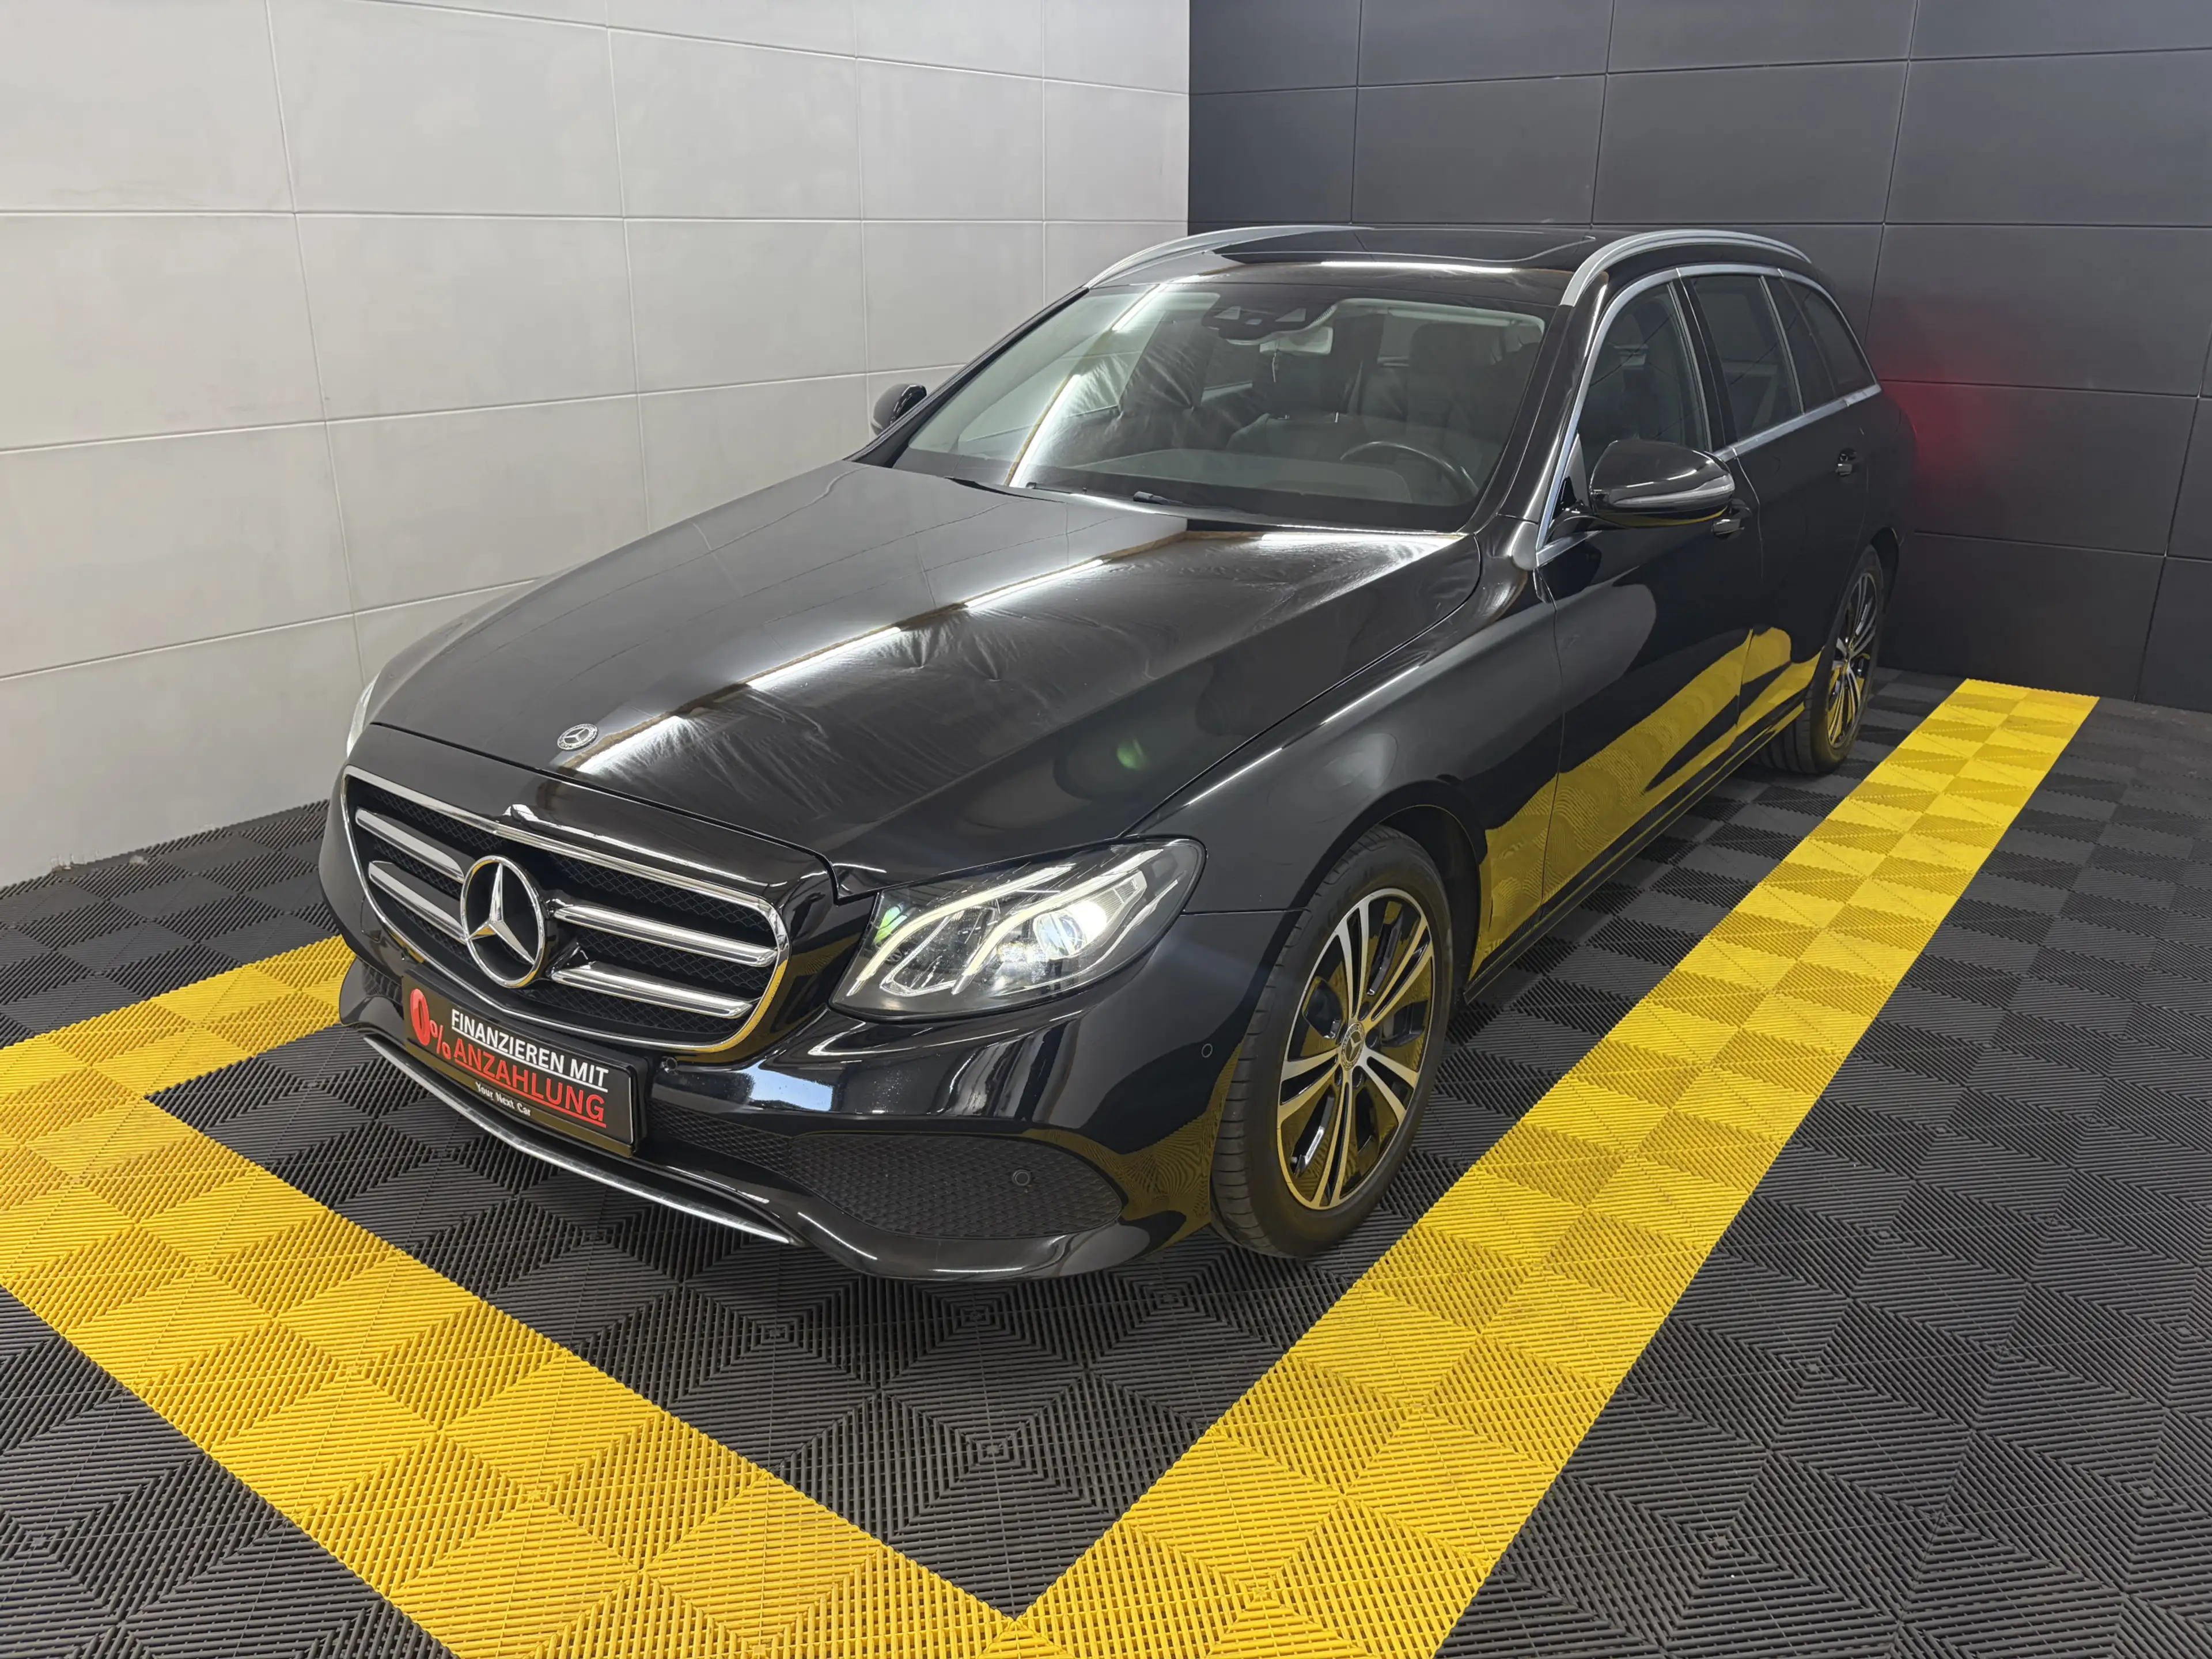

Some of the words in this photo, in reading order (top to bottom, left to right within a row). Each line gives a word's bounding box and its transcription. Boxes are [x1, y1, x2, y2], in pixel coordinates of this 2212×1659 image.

[410, 988, 452, 1060] 0%
[454, 1038, 605, 1122] ANZAHLUNG
[452, 1009, 565, 1074] FINANZIEREN
[570, 1059, 609, 1086] MIT
[475, 1081, 493, 1098] Your
[495, 1092, 515, 1109] Next
[517, 1103, 531, 1116] Car
